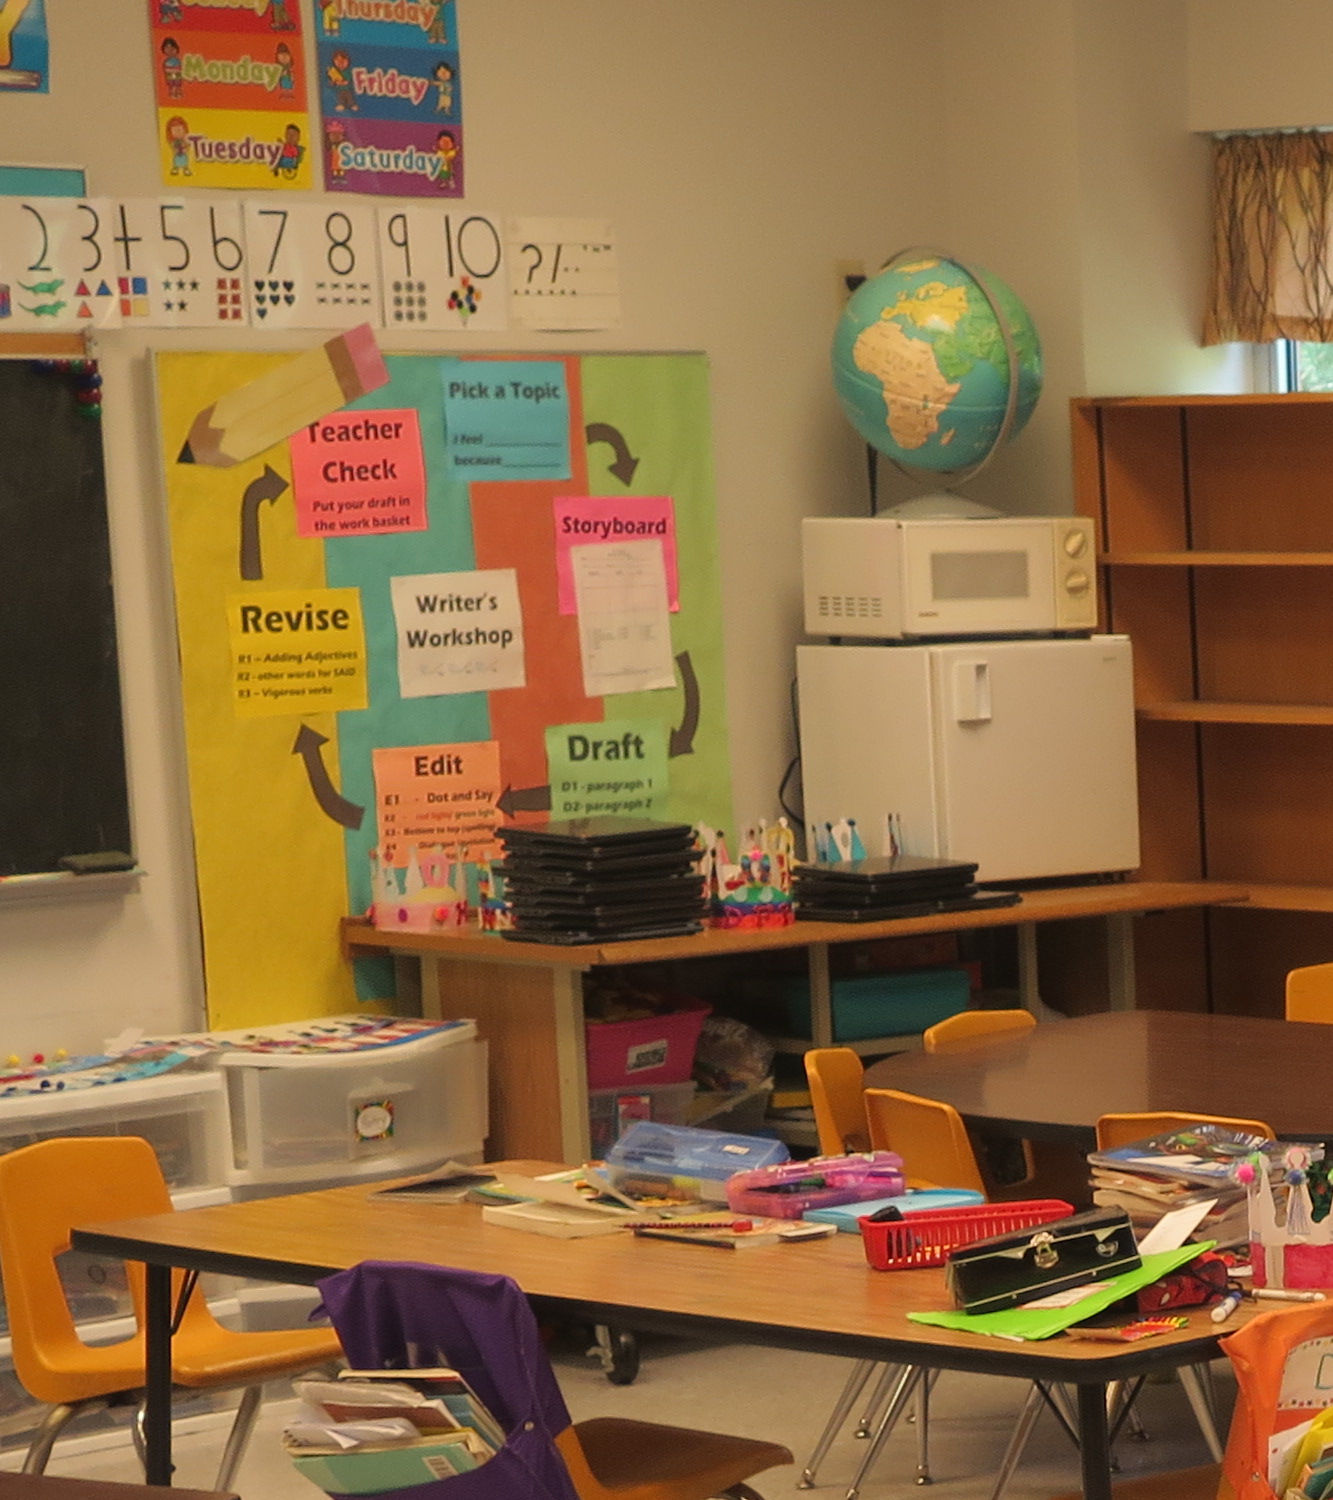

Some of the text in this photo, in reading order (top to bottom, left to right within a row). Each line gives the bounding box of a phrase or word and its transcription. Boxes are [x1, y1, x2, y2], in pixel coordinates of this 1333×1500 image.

[182, 55, 282, 91] Monday
[352, 70, 429, 104] Friday
[187, 135, 283, 166] Tuesday
[339, 145, 443, 179] Saturday
[21, 205, 51, 271] 2
[77, 205, 101, 271] 3
[160, 206, 190, 271] 5
[210, 206, 243, 271] 6
[258, 211, 289, 274] 7
[326, 212, 355, 275] 8
[388, 214, 411, 276] 9
[445, 214, 501, 279] 10
[449, 381, 560, 404] Pick a Topic
[309, 420, 403, 443] Teacher
[322, 460, 397, 484] Check
[454, 454, 502, 467] because
[313, 496, 411, 514] Put your draft in
[315, 515, 411, 532] the work basket
[561, 516, 667, 538] Storyboard
[416, 593, 498, 614] Writer's
[241, 602, 349, 633] Revise
[407, 627, 513, 650] Workshop
[264, 654, 303, 665] Adding
[305, 651, 358, 664] Adjectives
[288, 671, 316, 679] words
[261, 688, 306, 699] Vigorous
[568, 733, 645, 761] Draft
[415, 754, 463, 777] Edit
[427, 792, 448, 803] Dot
[451, 791, 471, 801] and
[475, 789, 493, 802] Say
